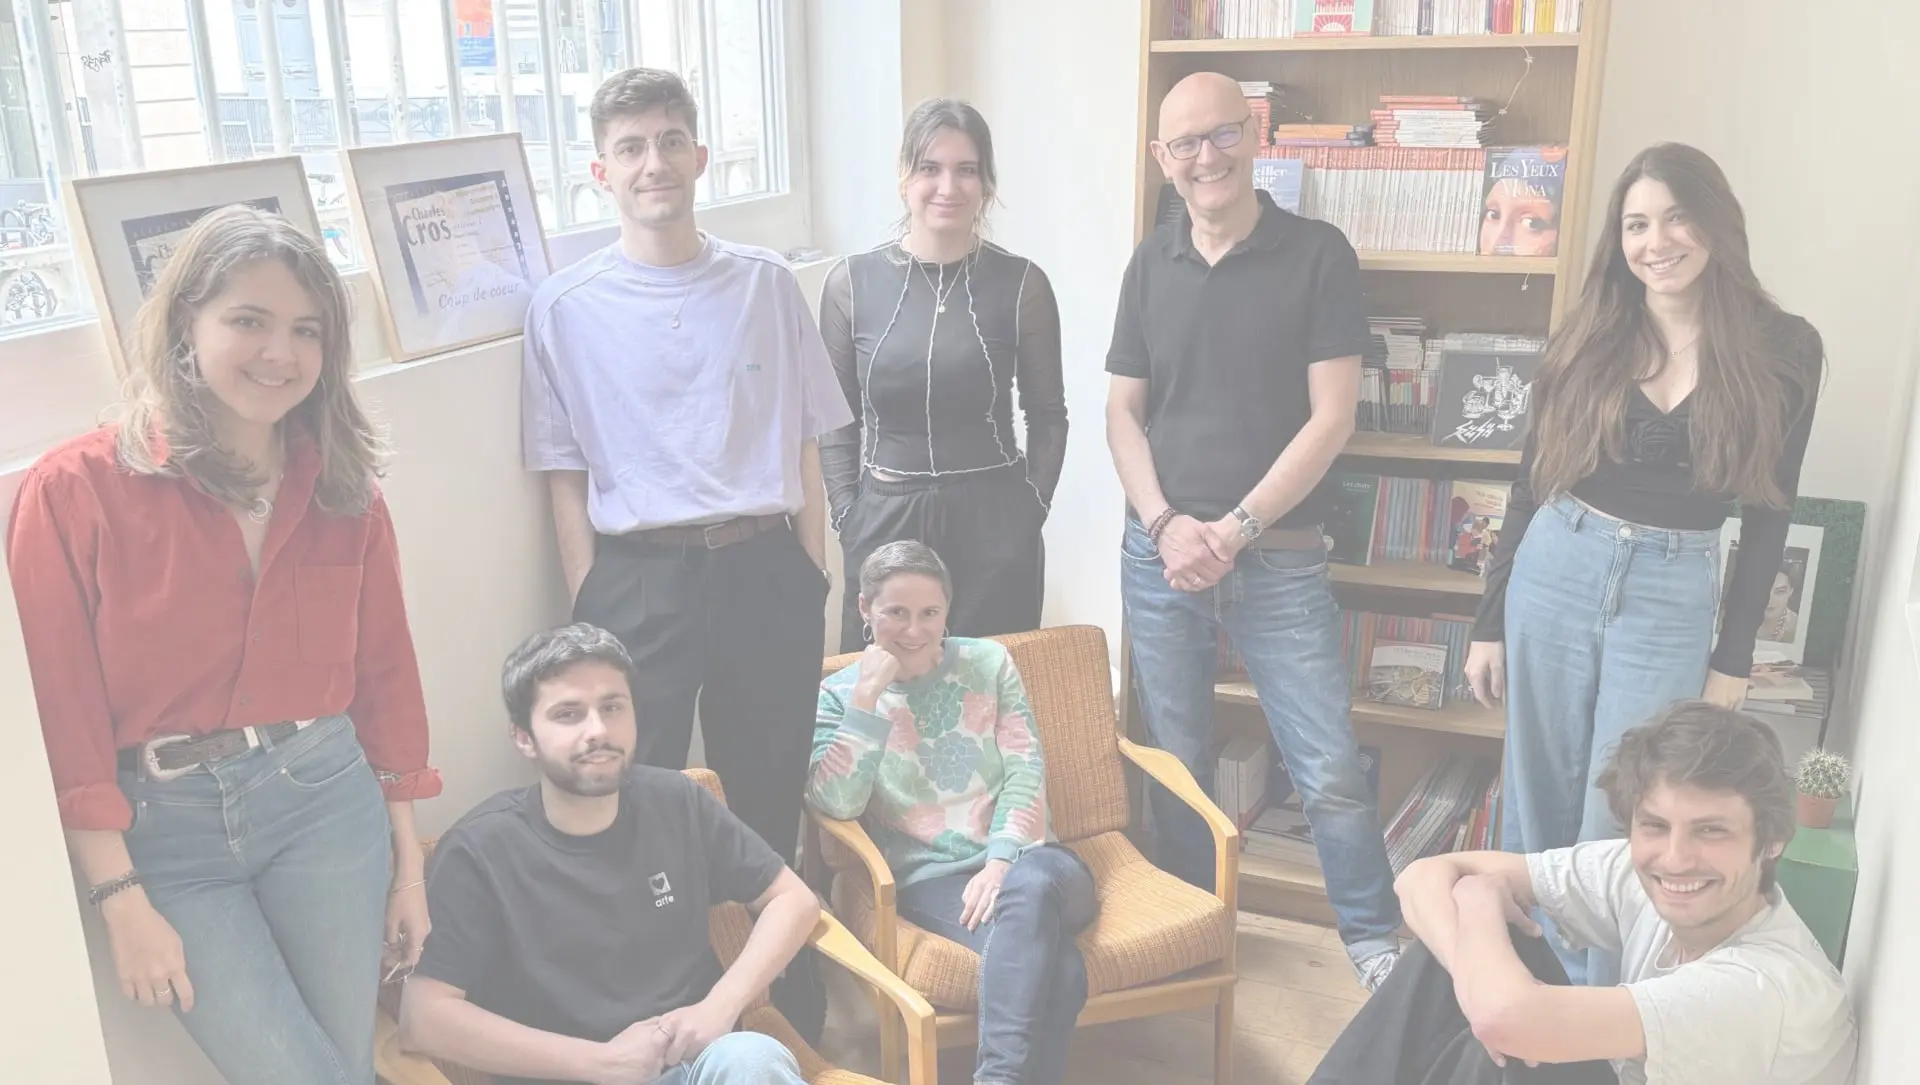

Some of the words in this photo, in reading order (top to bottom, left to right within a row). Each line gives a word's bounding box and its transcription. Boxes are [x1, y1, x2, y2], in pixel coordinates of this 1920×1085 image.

[1489, 161, 1519, 178] LES
[1521, 159, 1560, 178] YEUX
[411, 204, 446, 220] Charles
[402, 214, 452, 246] Cros
[438, 293, 470, 310] Coup
[473, 287, 487, 301] de
[489, 283, 520, 298] coeur
